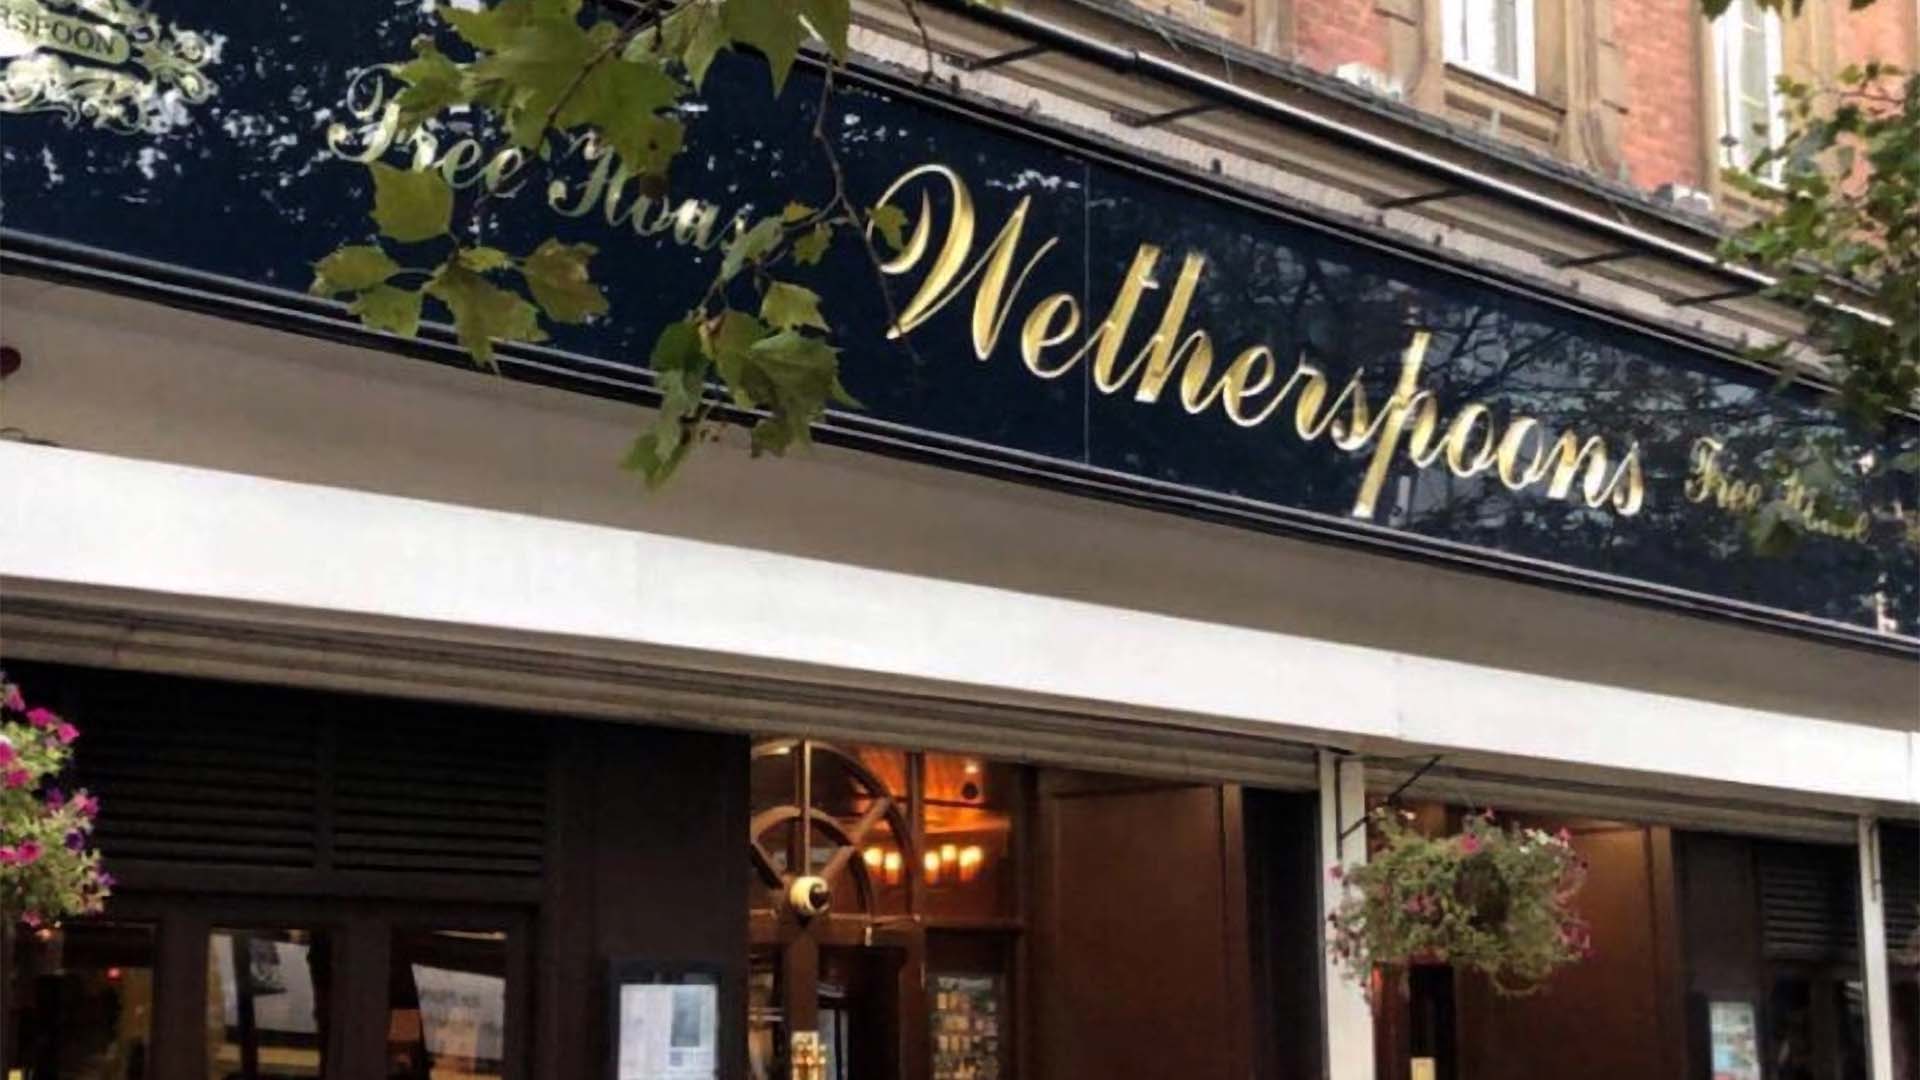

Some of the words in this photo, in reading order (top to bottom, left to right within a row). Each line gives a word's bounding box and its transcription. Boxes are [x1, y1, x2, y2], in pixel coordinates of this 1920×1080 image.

[328, 62, 527, 198] Free
[547, 127, 753, 250] Hou
[865, 163, 1643, 518] Wetherspoons
[1684, 436, 1762, 510] Free
